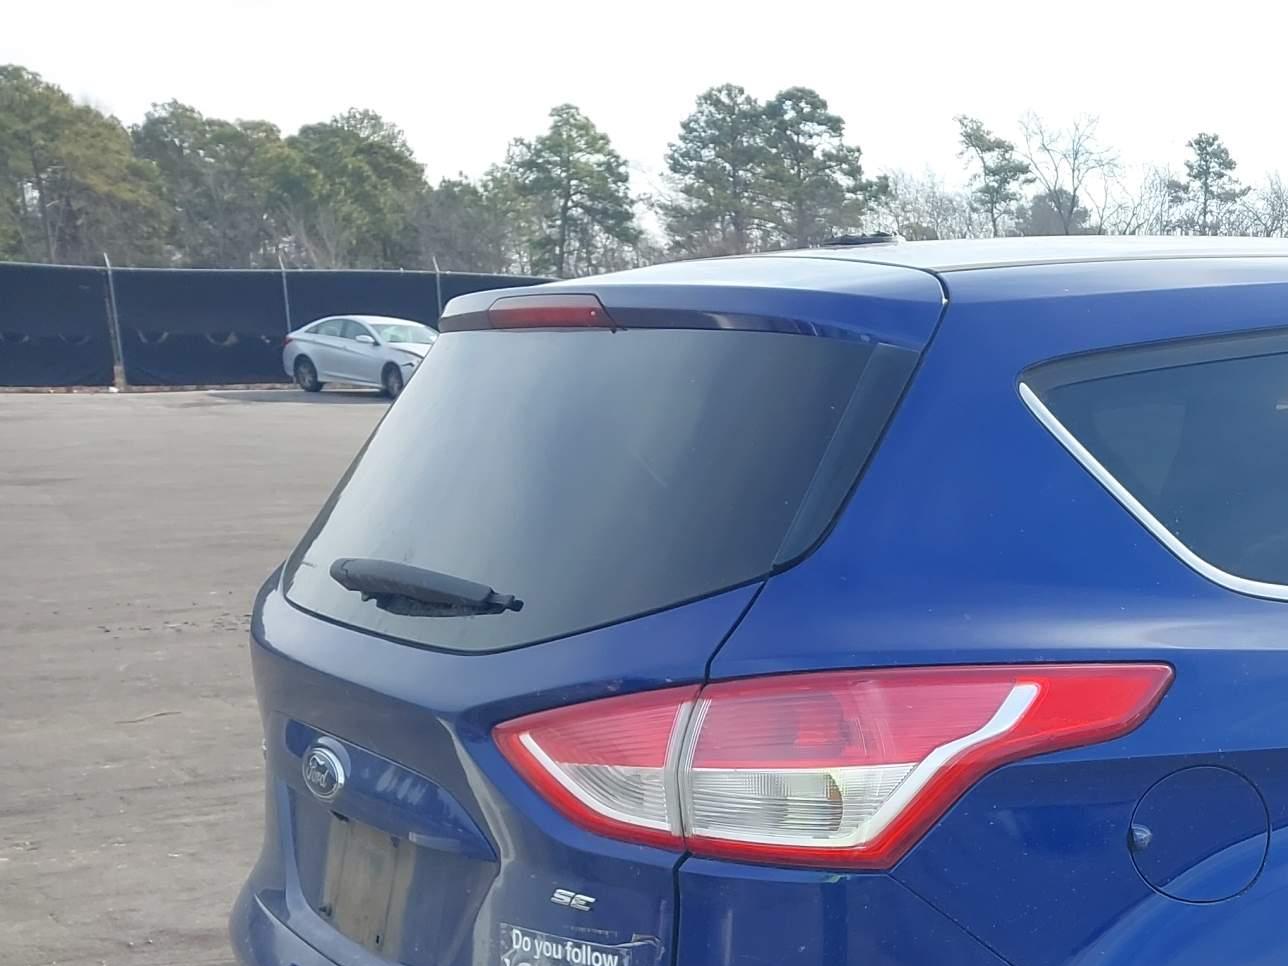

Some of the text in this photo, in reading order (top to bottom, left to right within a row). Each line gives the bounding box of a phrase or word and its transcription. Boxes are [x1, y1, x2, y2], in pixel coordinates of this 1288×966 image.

[550, 888, 597, 912] SE
[512, 928, 531, 951] Do
[534, 935, 562, 960] you
